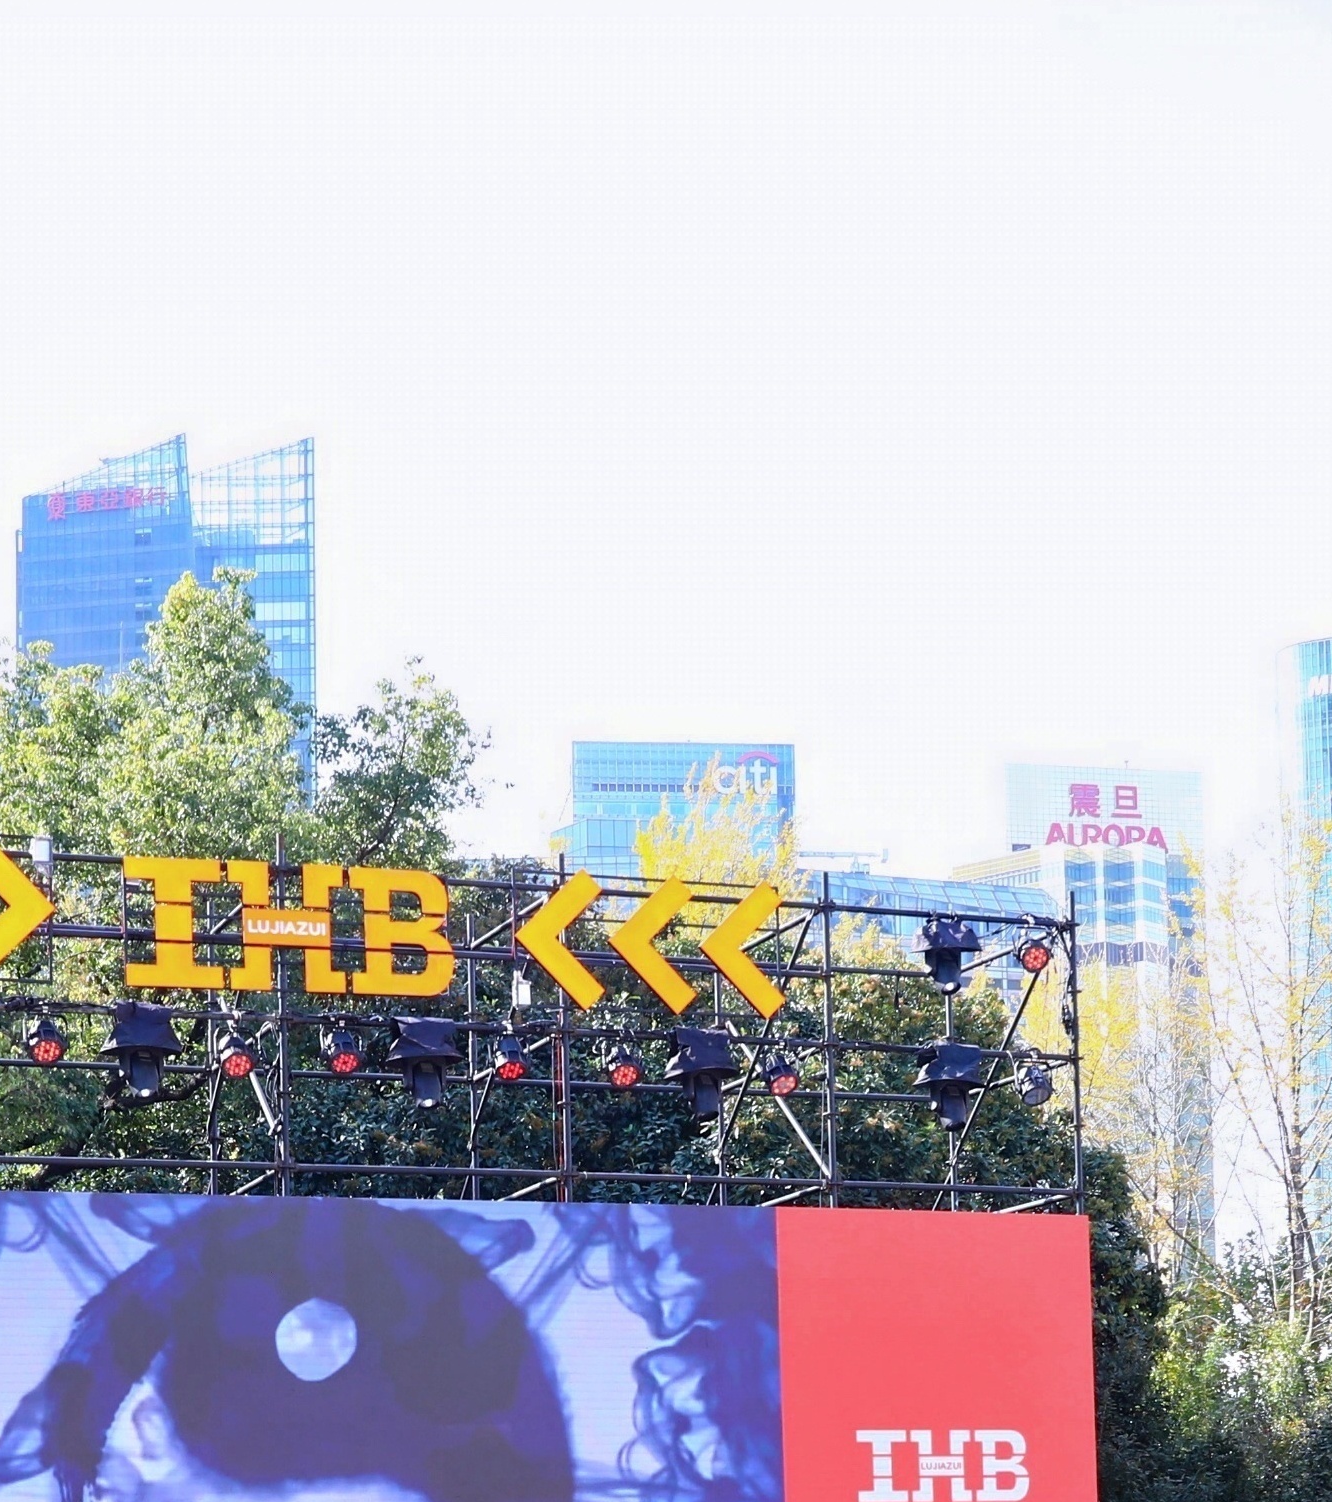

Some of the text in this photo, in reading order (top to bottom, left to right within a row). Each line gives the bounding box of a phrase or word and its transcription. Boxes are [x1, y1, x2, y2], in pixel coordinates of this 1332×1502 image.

[1068, 783, 1143, 819] 震旦
[123, 855, 456, 998] IHB
[246, 918, 328, 937] LUJIAZUI
[920, 1461, 962, 1471] LUJIAZUI
